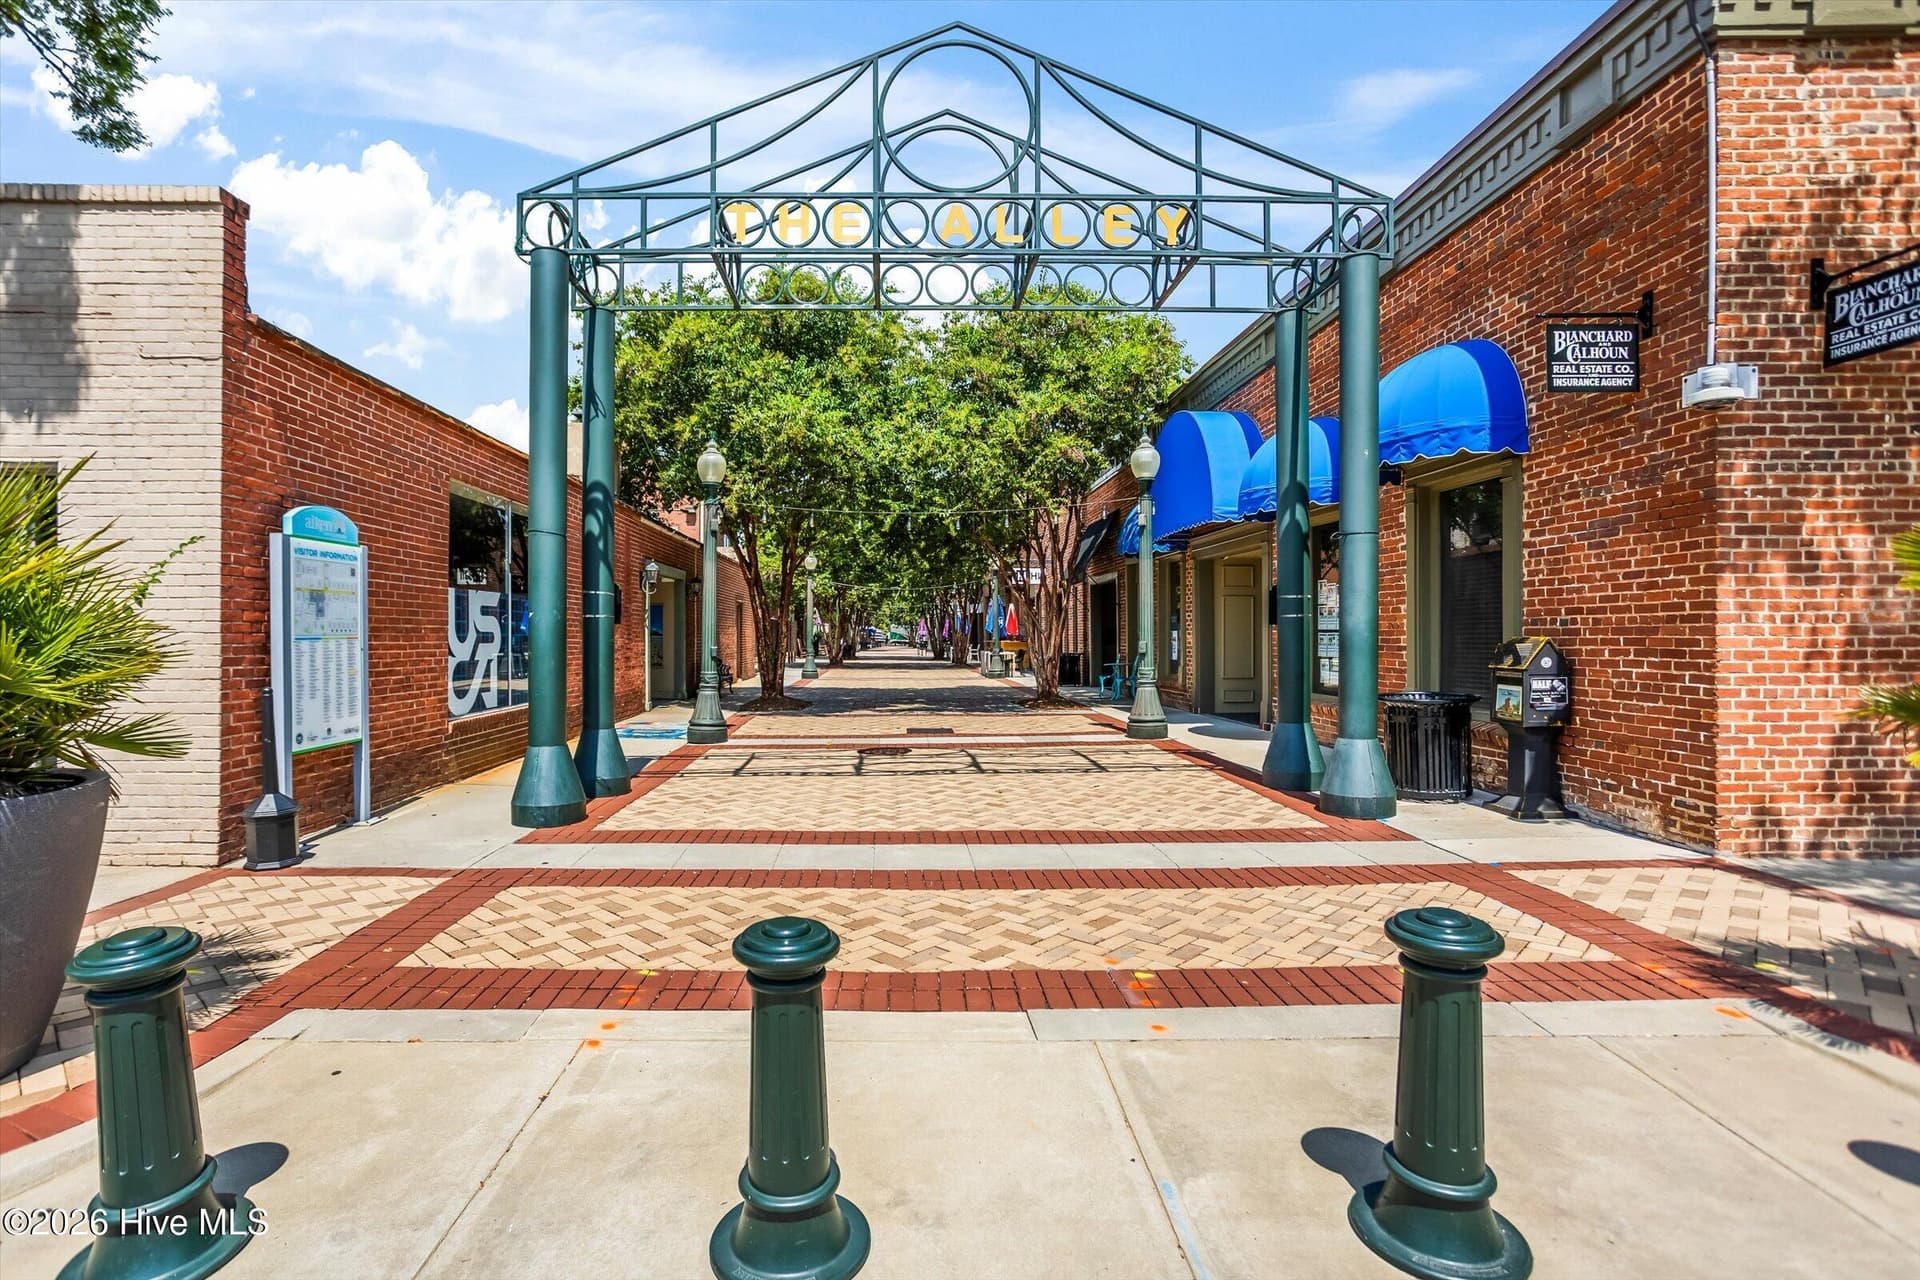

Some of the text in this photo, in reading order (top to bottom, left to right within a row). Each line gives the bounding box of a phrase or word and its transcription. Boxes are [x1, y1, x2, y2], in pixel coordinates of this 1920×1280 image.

[726, 205, 1187, 246] THE ALLEY
[1831, 328, 1860, 344] REAL
[1864, 313, 1906, 334] ESTATE
[1553, 330, 1633, 355] BLANCHARD
[1566, 343, 1629, 365] CALHOUN
[1831, 334, 1888, 359] INSURANCE
[1553, 365, 1634, 374] REAL ESTATE CO.
[1553, 378, 1634, 387] INSURANCE AGENCY
[294, 546, 358, 562] VISITOR INFORMATION
